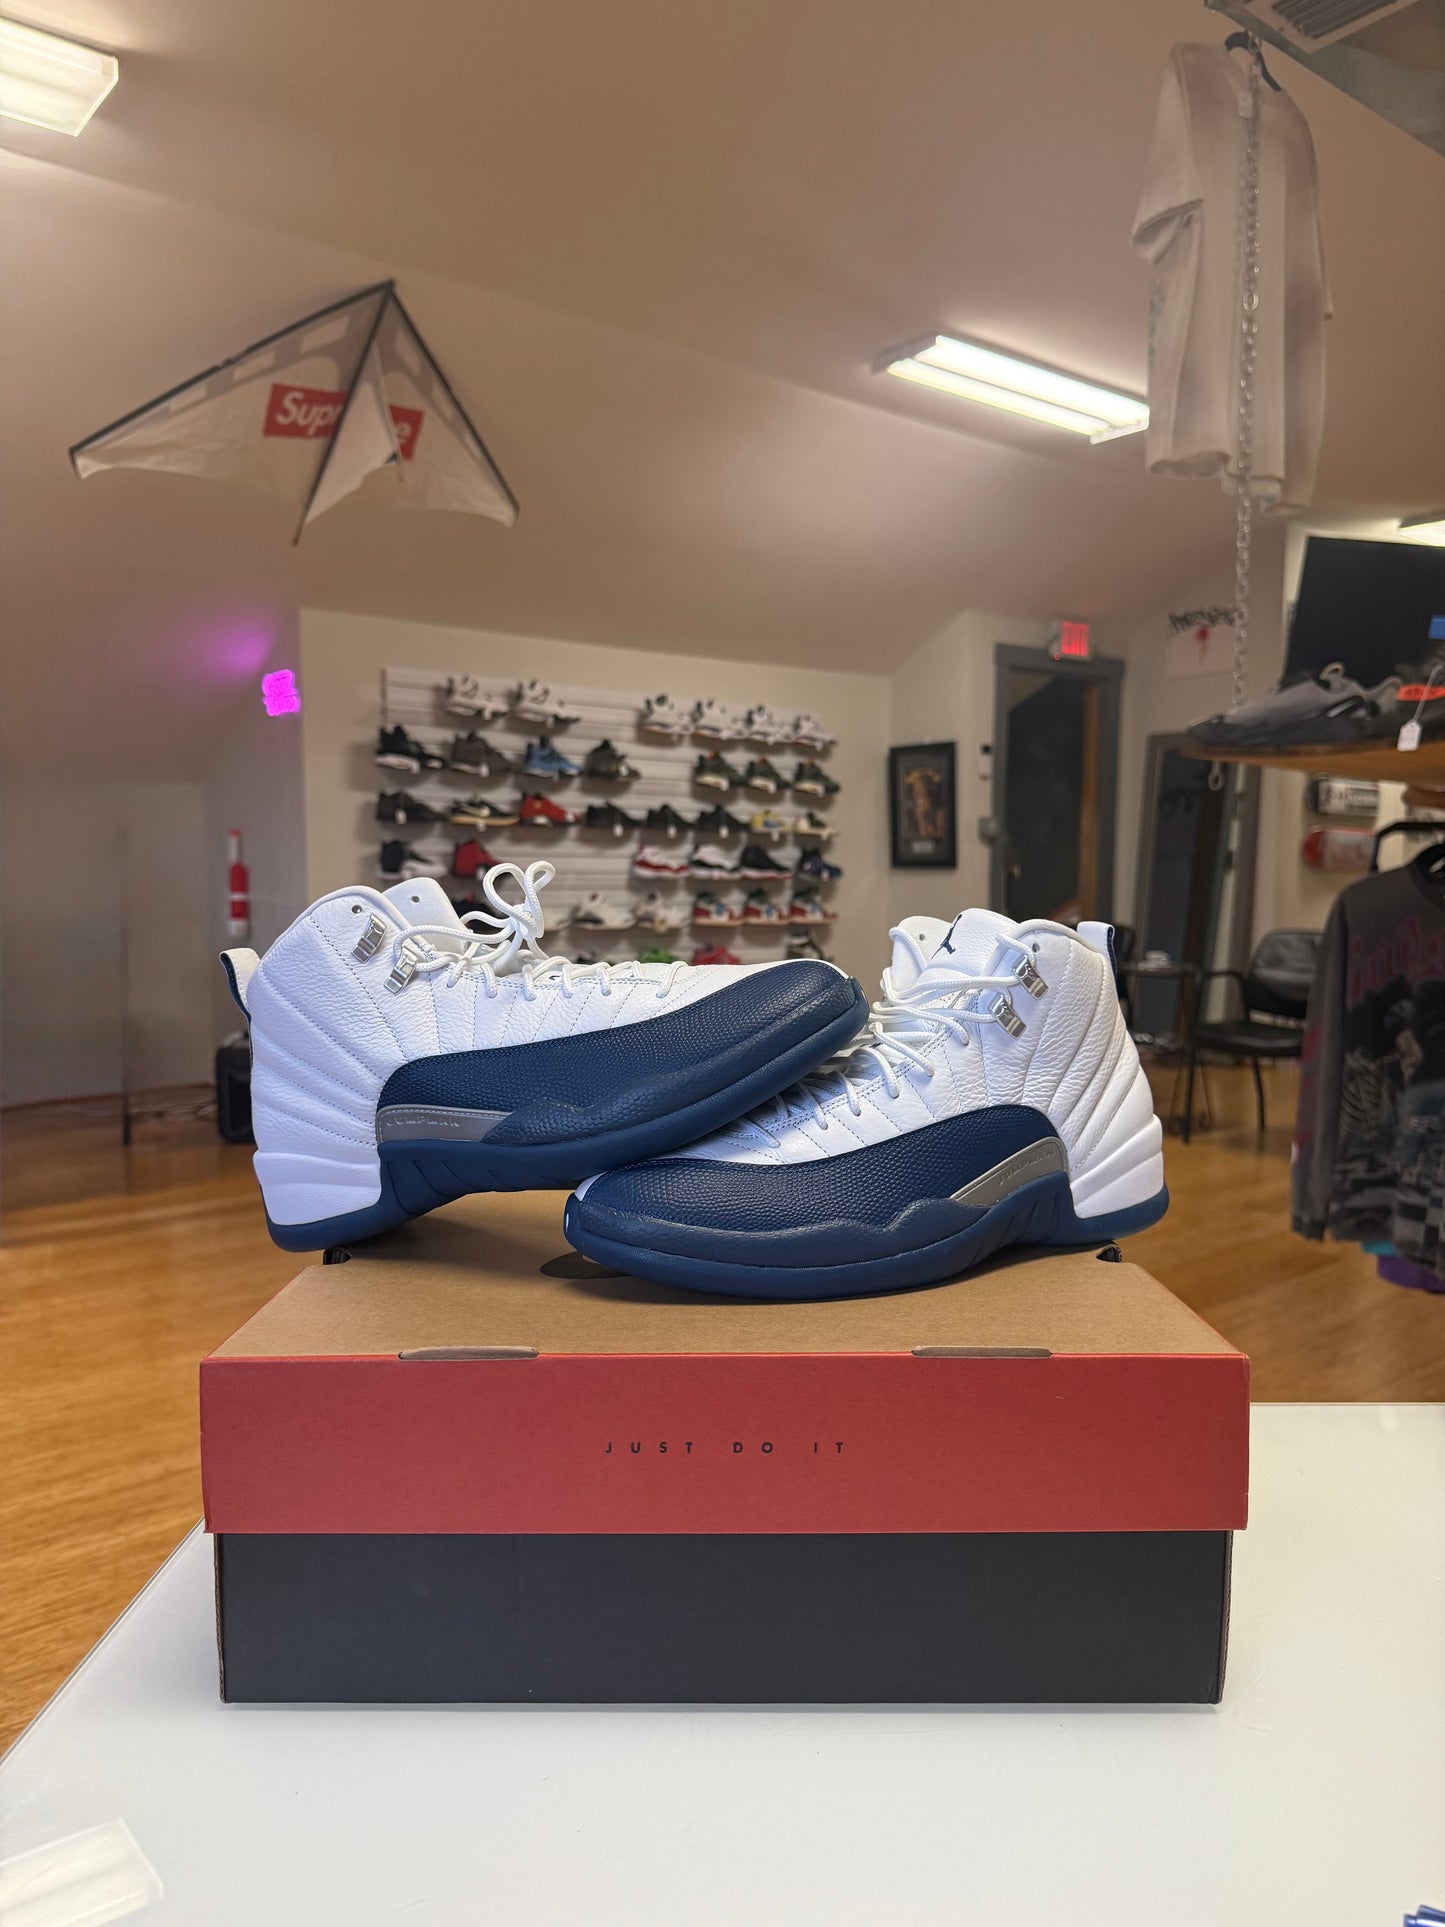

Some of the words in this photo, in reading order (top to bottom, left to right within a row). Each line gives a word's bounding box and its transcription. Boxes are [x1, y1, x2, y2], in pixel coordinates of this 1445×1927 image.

[275, 391, 412, 444] Supe
[605, 1442, 693, 1454] JUST
[732, 1442, 773, 1454] DO
[813, 1442, 844, 1454] IT
